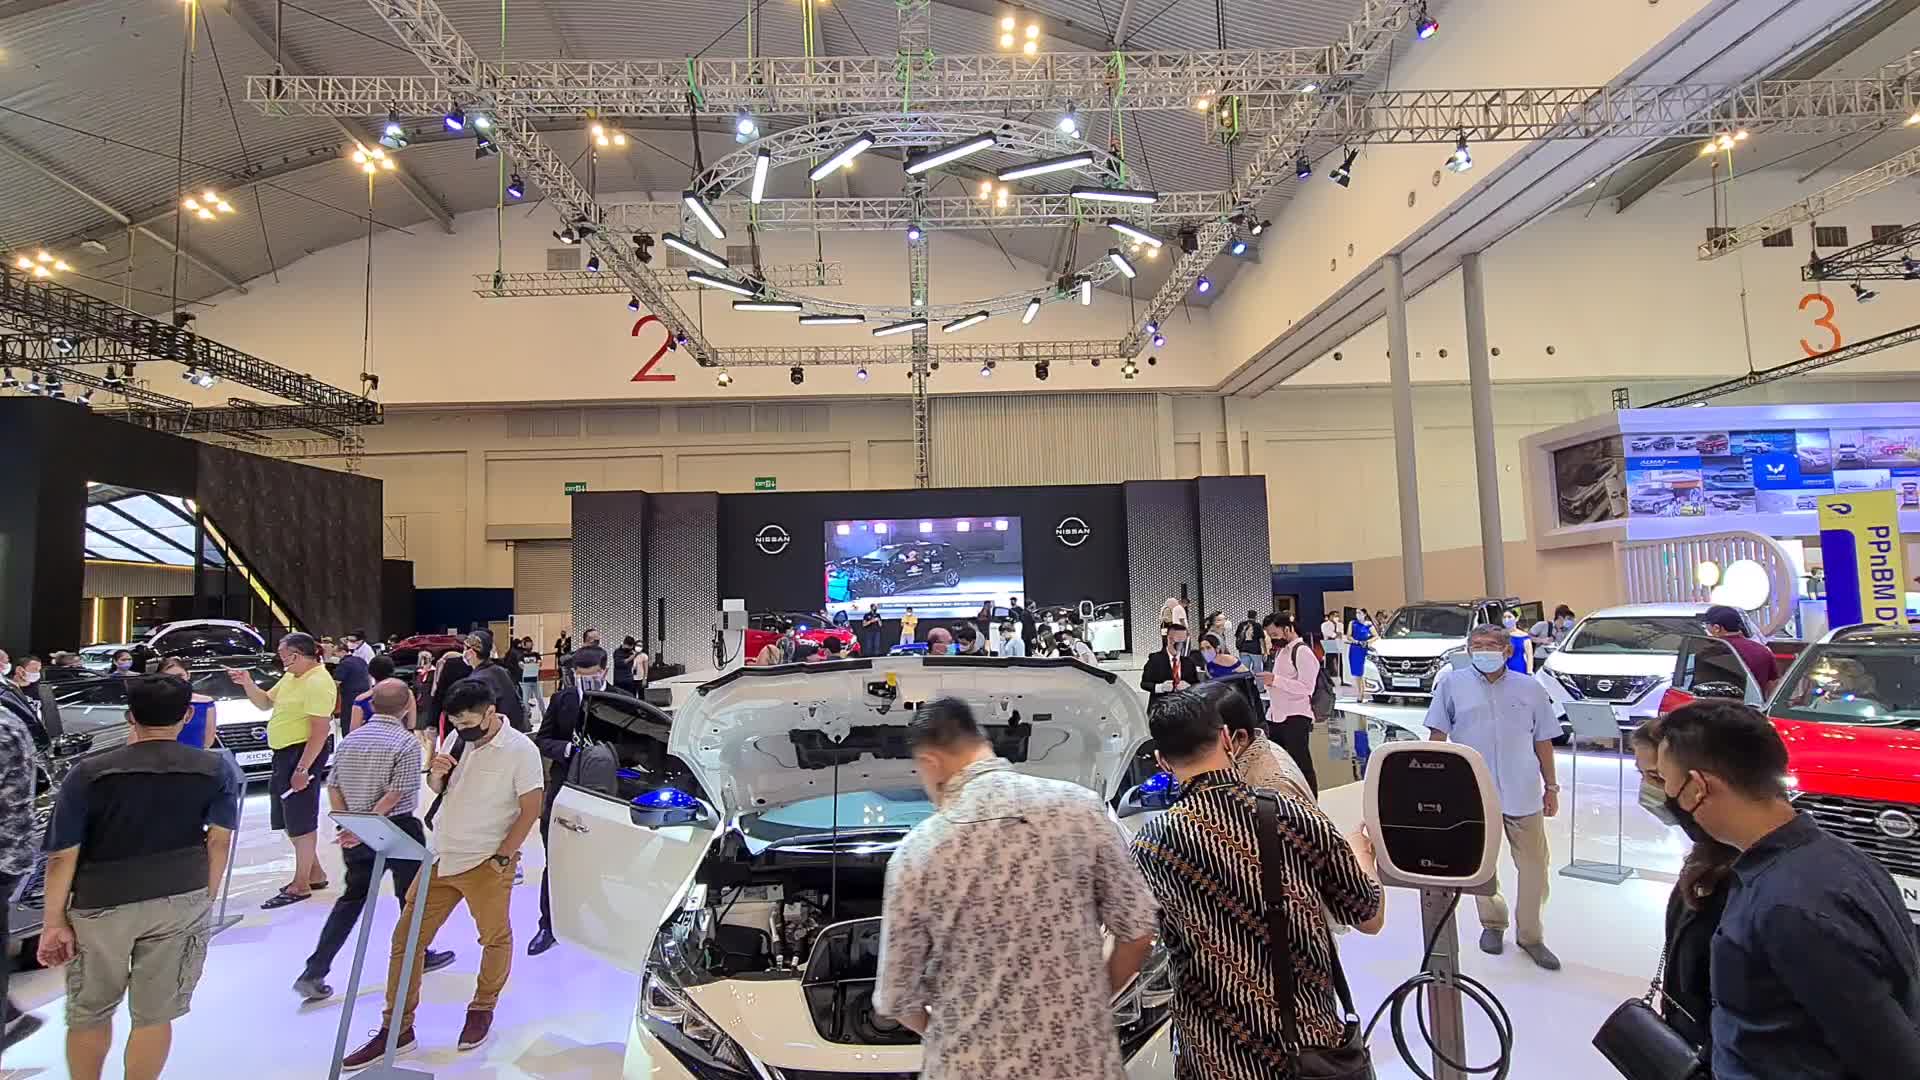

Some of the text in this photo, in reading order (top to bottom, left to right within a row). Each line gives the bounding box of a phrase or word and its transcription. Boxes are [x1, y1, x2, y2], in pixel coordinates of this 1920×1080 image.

[631, 315, 676, 382] 2
[1799, 294, 1841, 357] 3
[1867, 525, 1898, 625] PPnBM D
